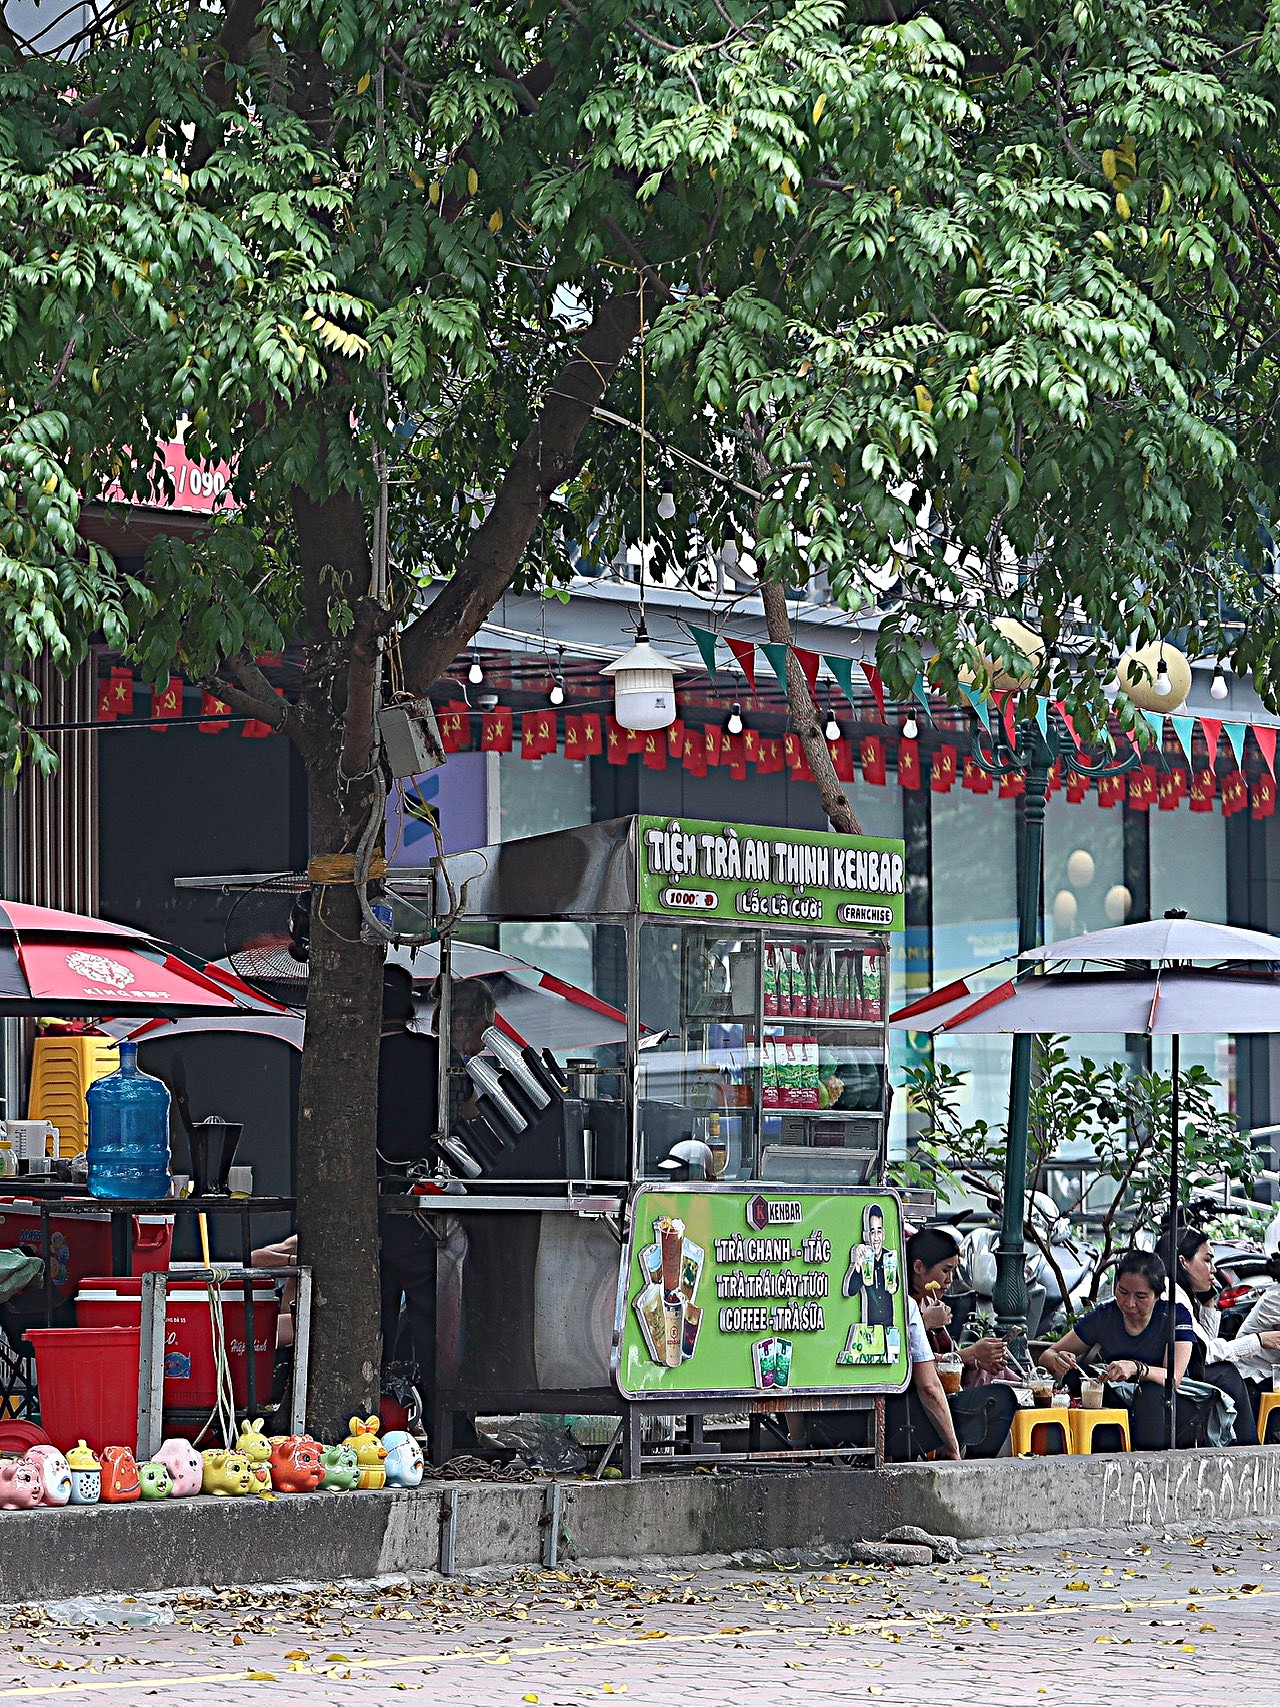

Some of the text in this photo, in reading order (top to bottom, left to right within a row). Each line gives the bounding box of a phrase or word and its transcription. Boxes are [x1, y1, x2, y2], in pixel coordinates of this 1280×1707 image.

[646, 820, 904, 895] TIỆM TRÀ AN THỊNH KENBAR
[845, 905, 891, 922] FRANCHISE
[769, 1203, 801, 1221] KENBAR
[718, 1233, 744, 1262] TRÀ
[746, 1238, 790, 1262] CHANH
[807, 1230, 831, 1262] TẮC
[721, 1269, 829, 1298] TRÀ TRÁI CÂY TƯƠI
[723, 1306, 767, 1331] COFFEE
[776, 1302, 800, 1331] TRÀ
[801, 1302, 825, 1331] SỮA
